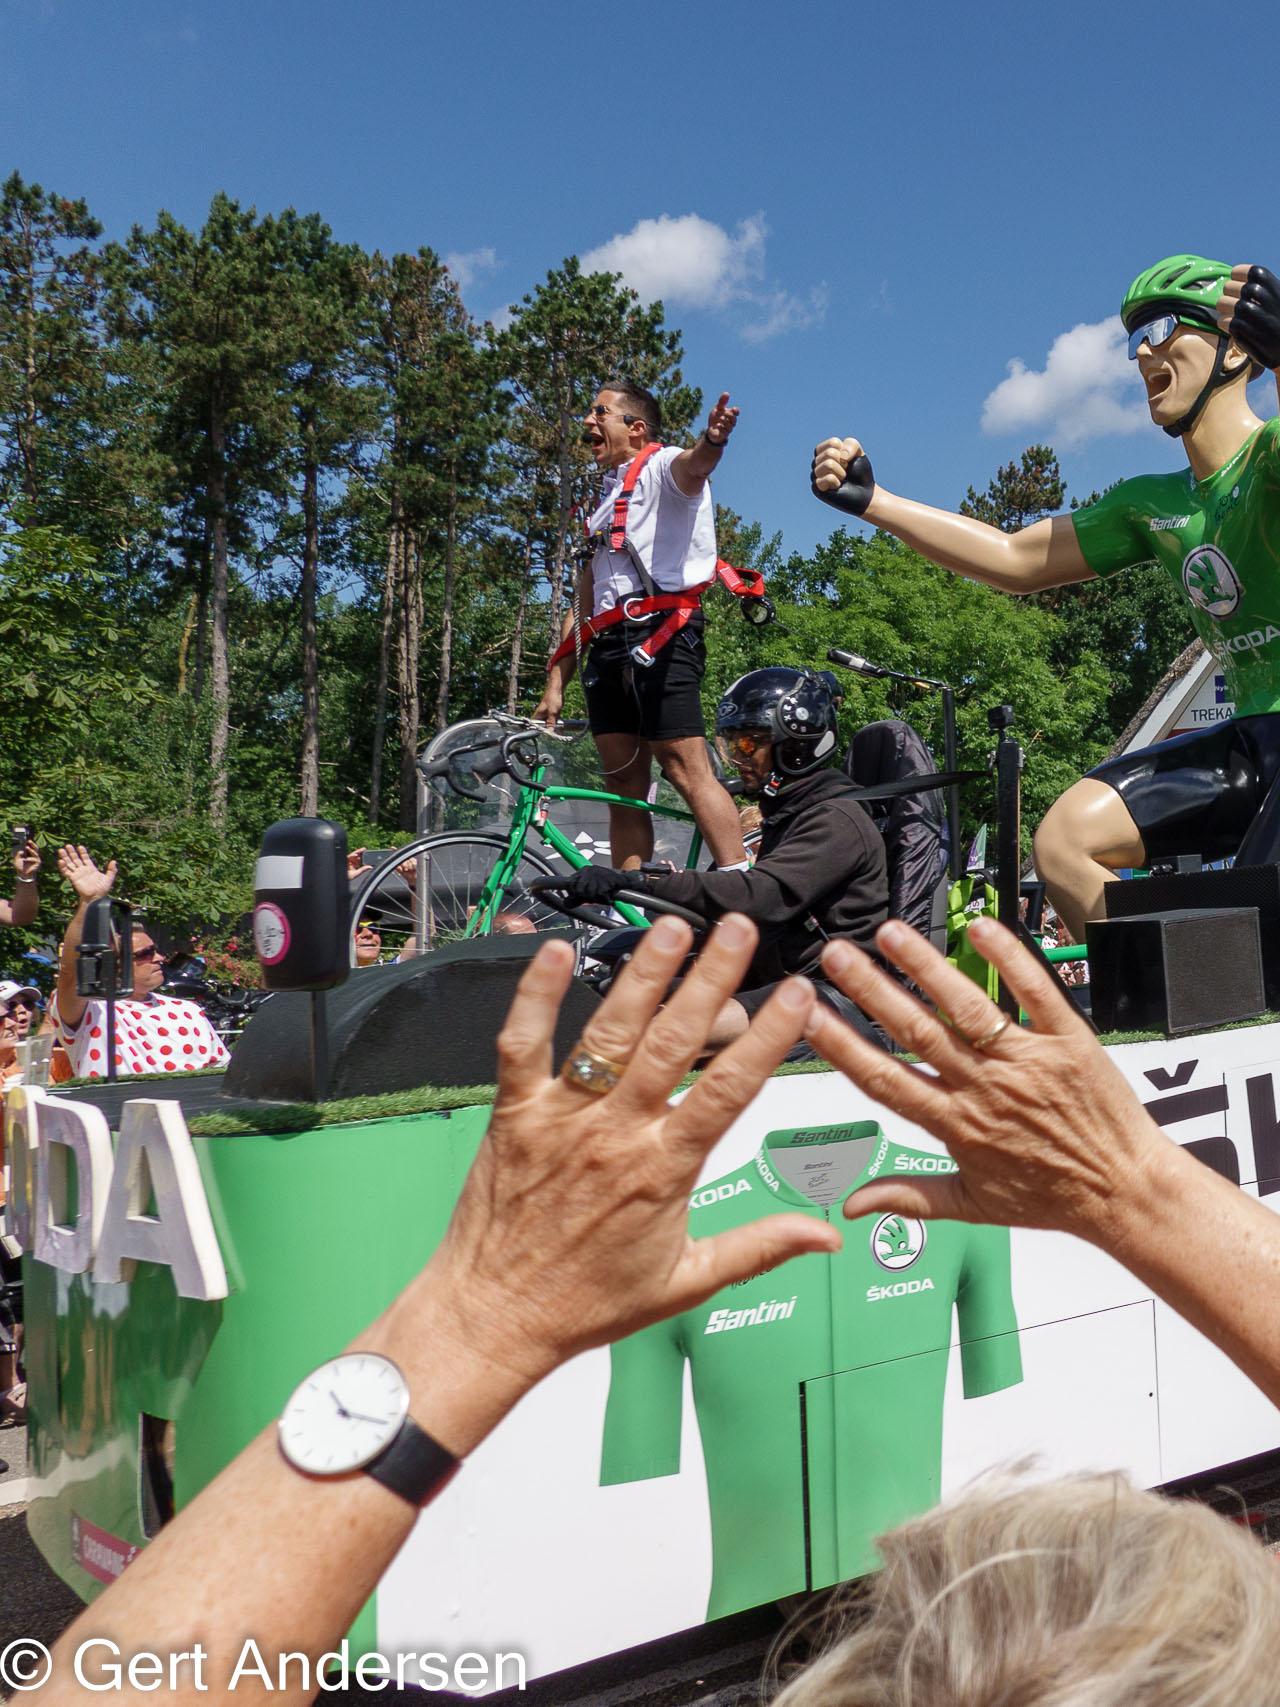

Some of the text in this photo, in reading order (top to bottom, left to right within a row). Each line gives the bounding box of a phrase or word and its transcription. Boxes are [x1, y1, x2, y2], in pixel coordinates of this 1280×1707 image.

[1149, 514, 1191, 532] Santini
[1190, 706, 1234, 723] TREKA
[790, 1126, 854, 1145] Santini
[689, 1178, 752, 1209] KODA
[866, 1277, 935, 1302] ŠKODA
[704, 1296, 798, 1335] Santini
